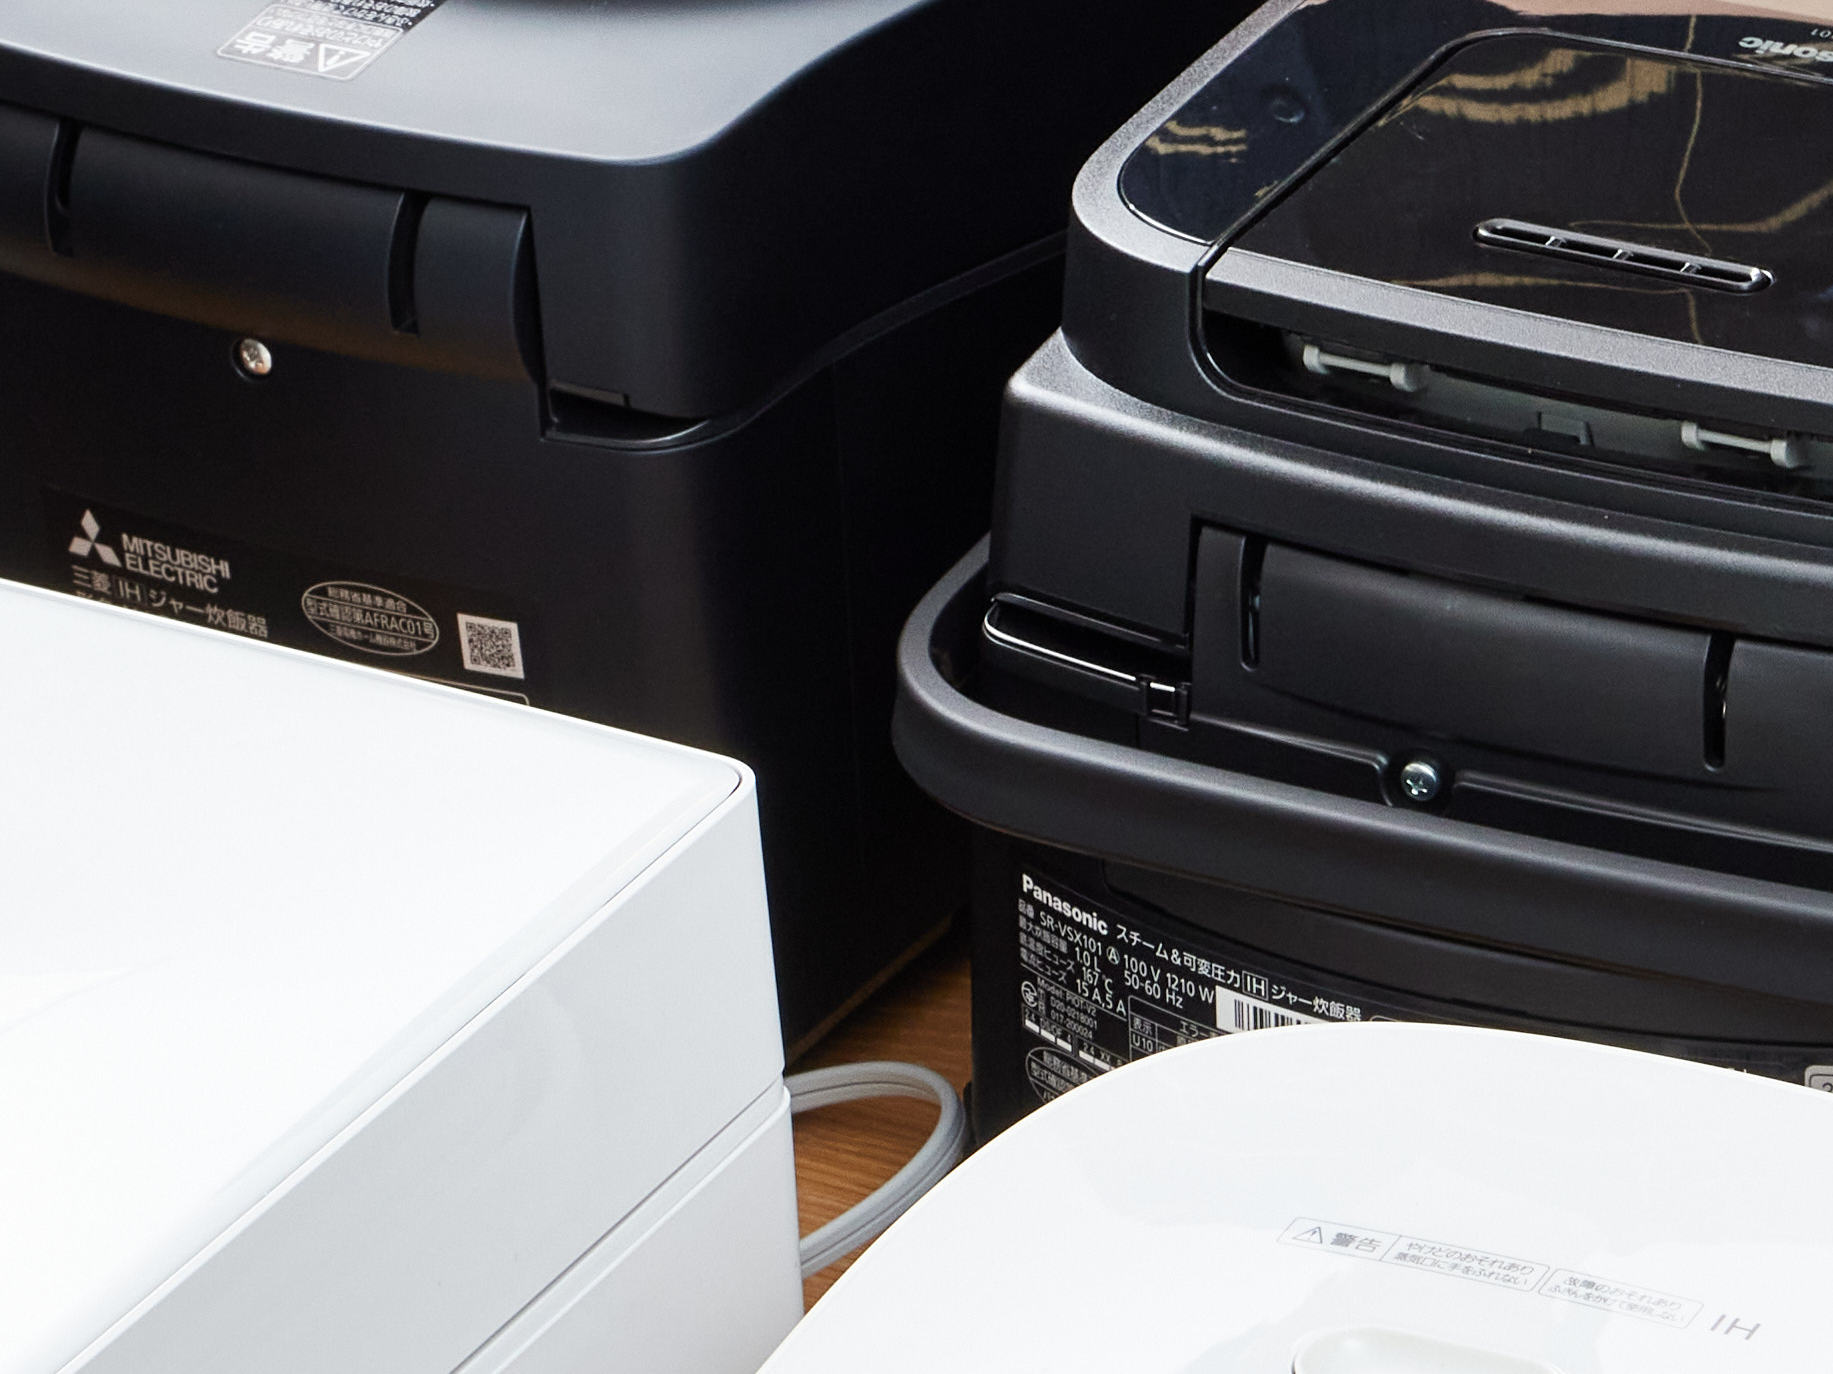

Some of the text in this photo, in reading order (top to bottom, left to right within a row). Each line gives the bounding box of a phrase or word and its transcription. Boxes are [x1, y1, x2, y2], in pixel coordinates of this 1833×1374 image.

[122, 533, 231, 578] MITSUBISHI
[125, 553, 219, 593] ELECTRIC
[119, 580, 143, 601] IH
[148, 589, 269, 639] ジャー炊飯器
[1022, 874, 1108, 935] Panasonic
[1246, 974, 1266, 997] IH
[1039, 911, 1102, 956] SR-VSX101
[1123, 954, 1147, 976] 100
[1166, 973, 1195, 997] 1210
[1123, 972, 1161, 999] 50-60
[1166, 991, 1184, 1009] Hz
[1132, 1036, 1153, 1052] U10
[1330, 1232, 1381, 1253] 警告
[1405, 1241, 1534, 1276] やけどのおそれあり
[1709, 1313, 1762, 1341] IH
